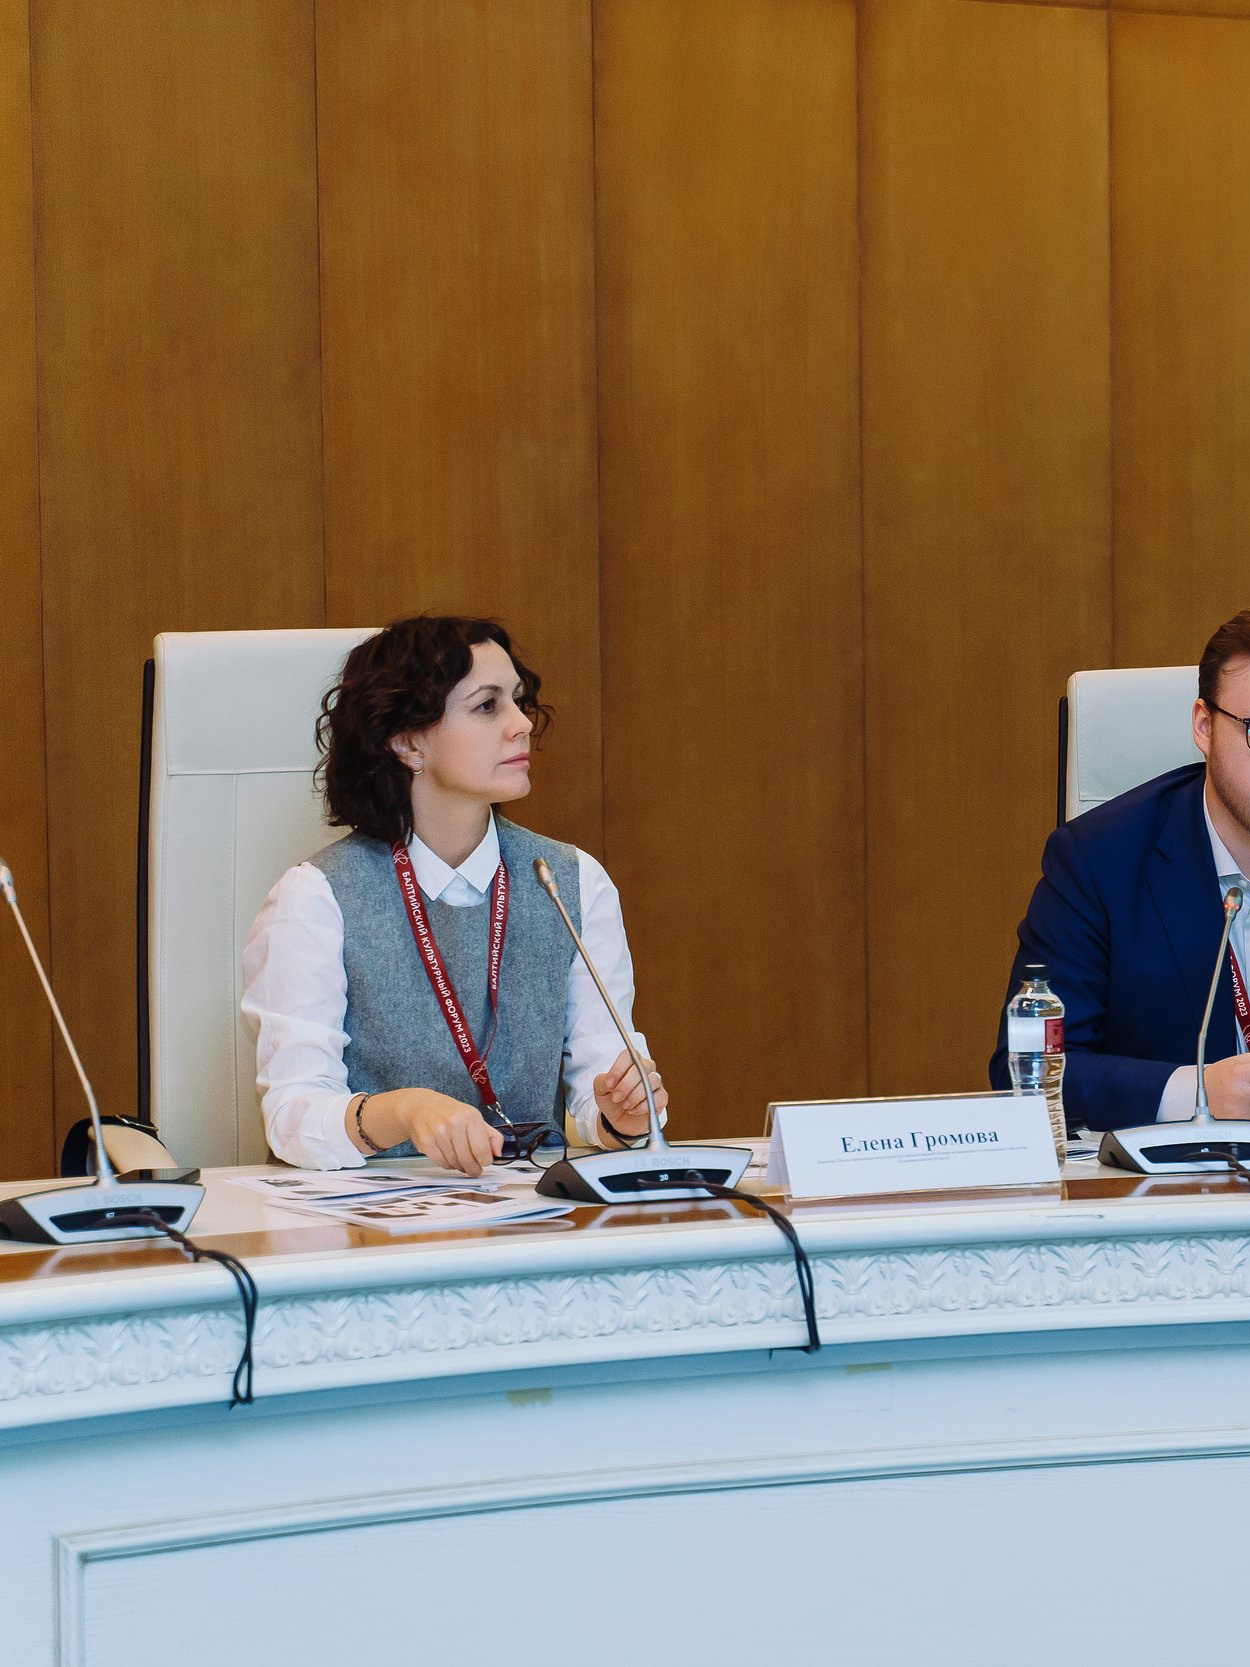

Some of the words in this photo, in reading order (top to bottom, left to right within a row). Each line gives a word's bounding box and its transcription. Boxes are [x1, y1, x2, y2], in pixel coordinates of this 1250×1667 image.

[402, 871, 428, 938] БАЛТИЙСКИЙ
[422, 936, 450, 999] КУЛЬТУРНЫЙ
[445, 998, 464, 1034] ФОРУМ
[458, 1030, 472, 1054] 2023
[1236, 998, 1248, 1016] 2023
[840, 1135, 904, 1154] Елена
[910, 1130, 999, 1152] Громова
[652, 1156, 690, 1168] BOSCH
